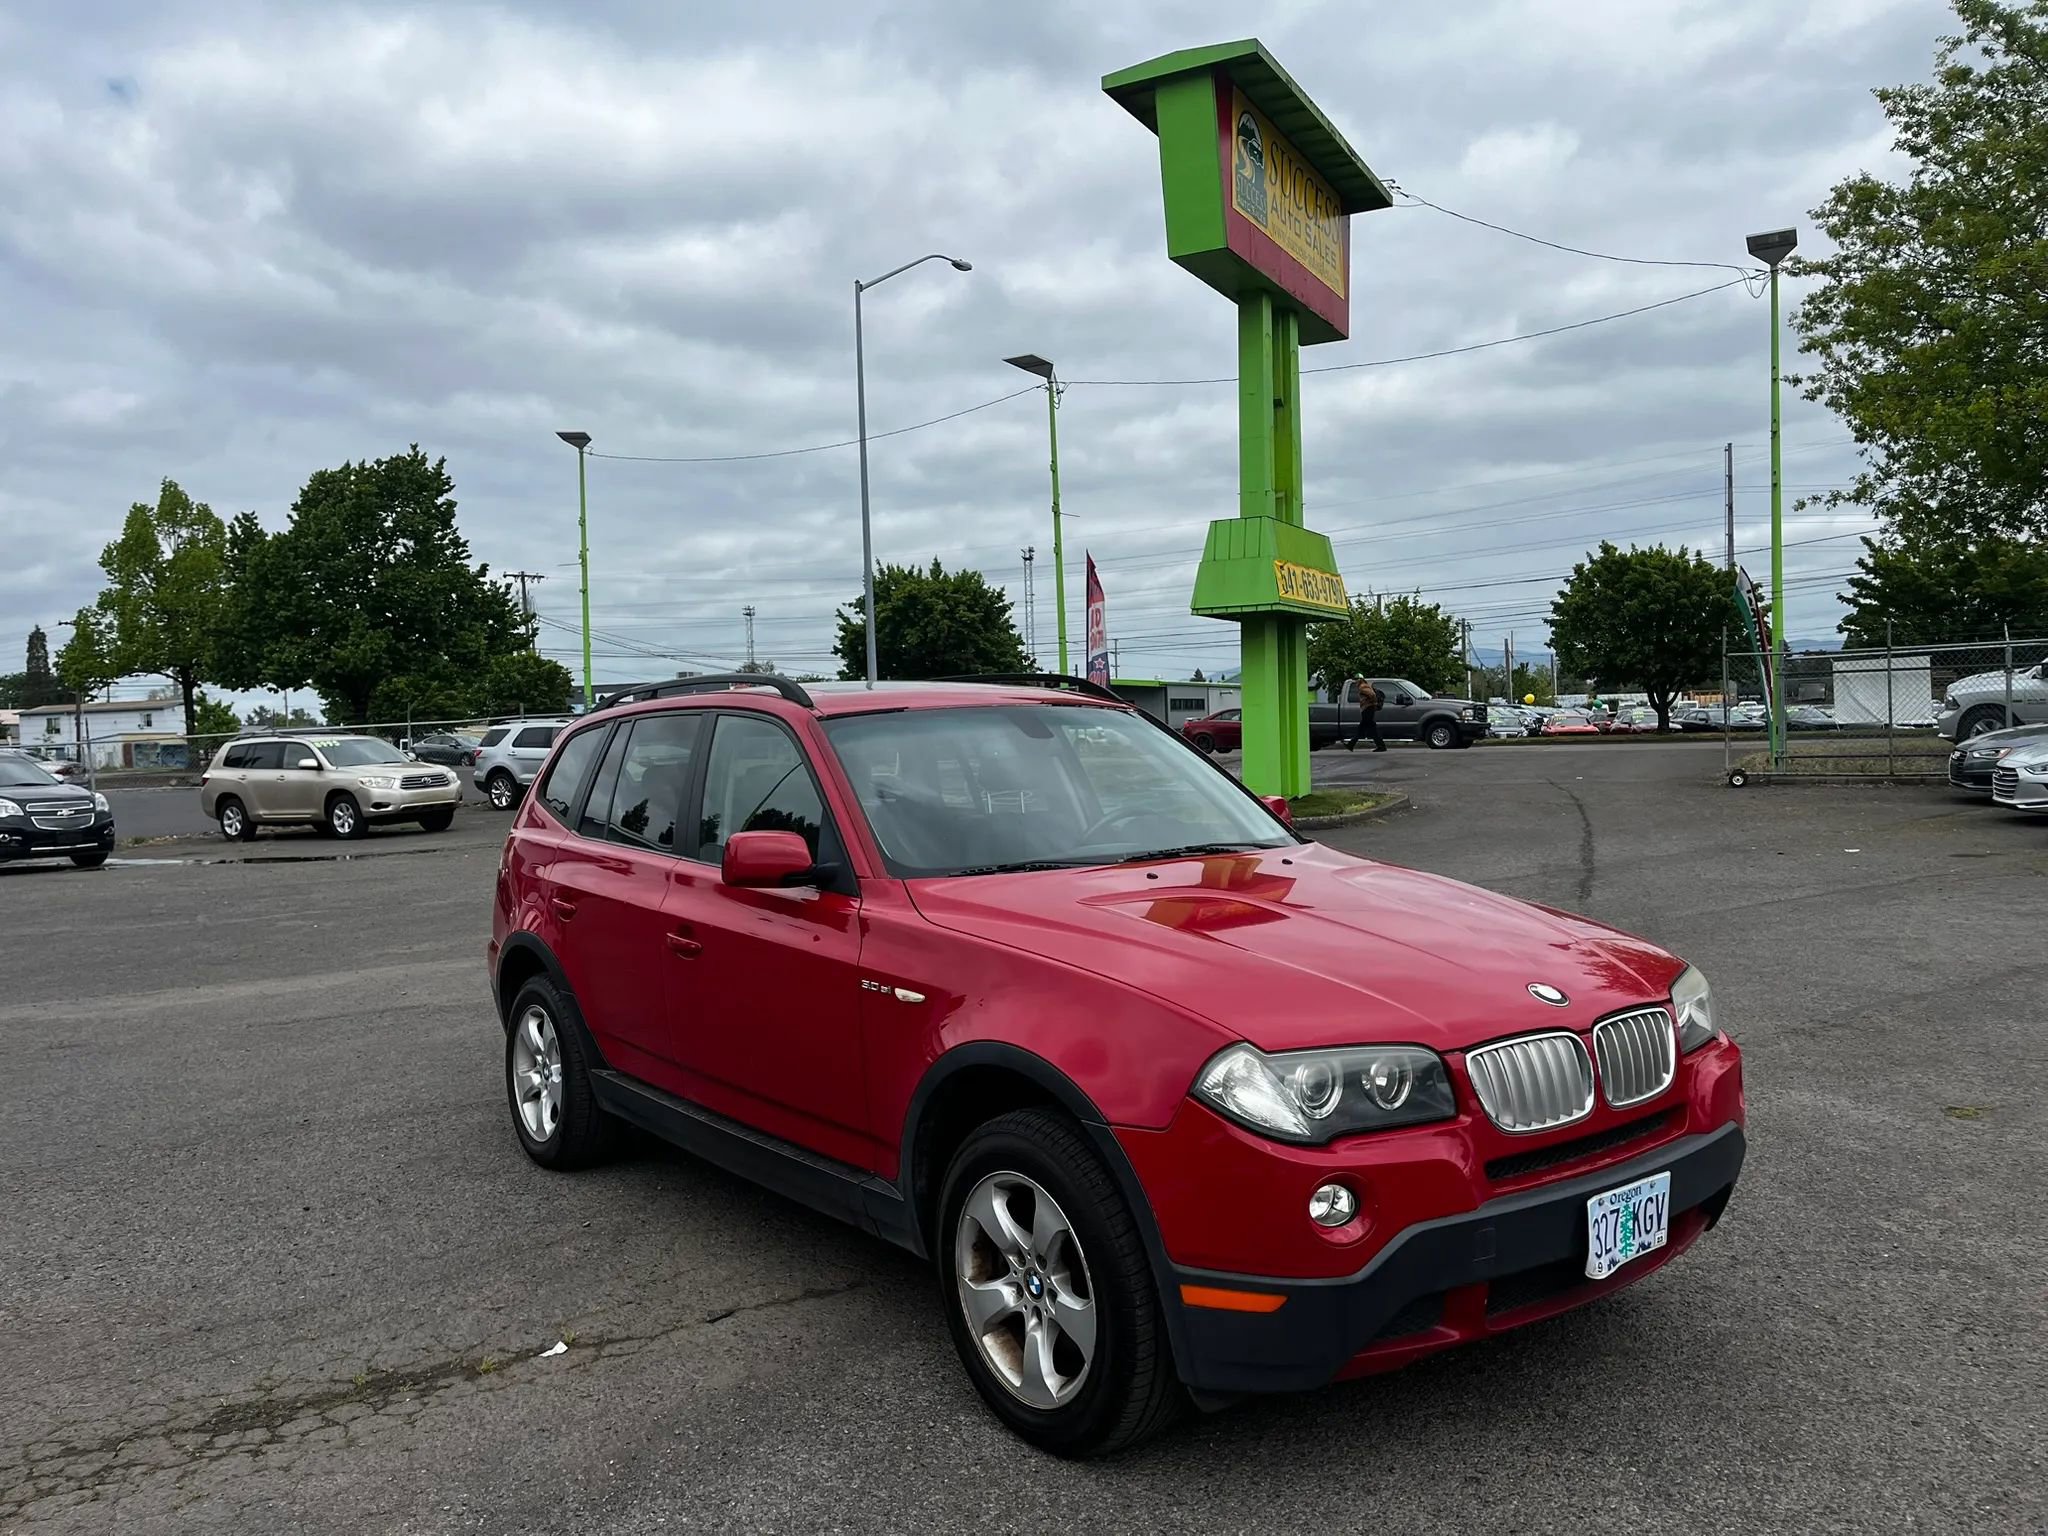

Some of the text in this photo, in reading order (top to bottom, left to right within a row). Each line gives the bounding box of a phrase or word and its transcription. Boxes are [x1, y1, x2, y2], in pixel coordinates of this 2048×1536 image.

[1269, 141, 1340, 245] SUCCESS
[1270, 192, 1301, 238] AUTO
[1305, 222, 1337, 271] SALES
[1592, 1191, 1666, 1259] 327 KGV
[1609, 1185, 1642, 1206] Oregon
